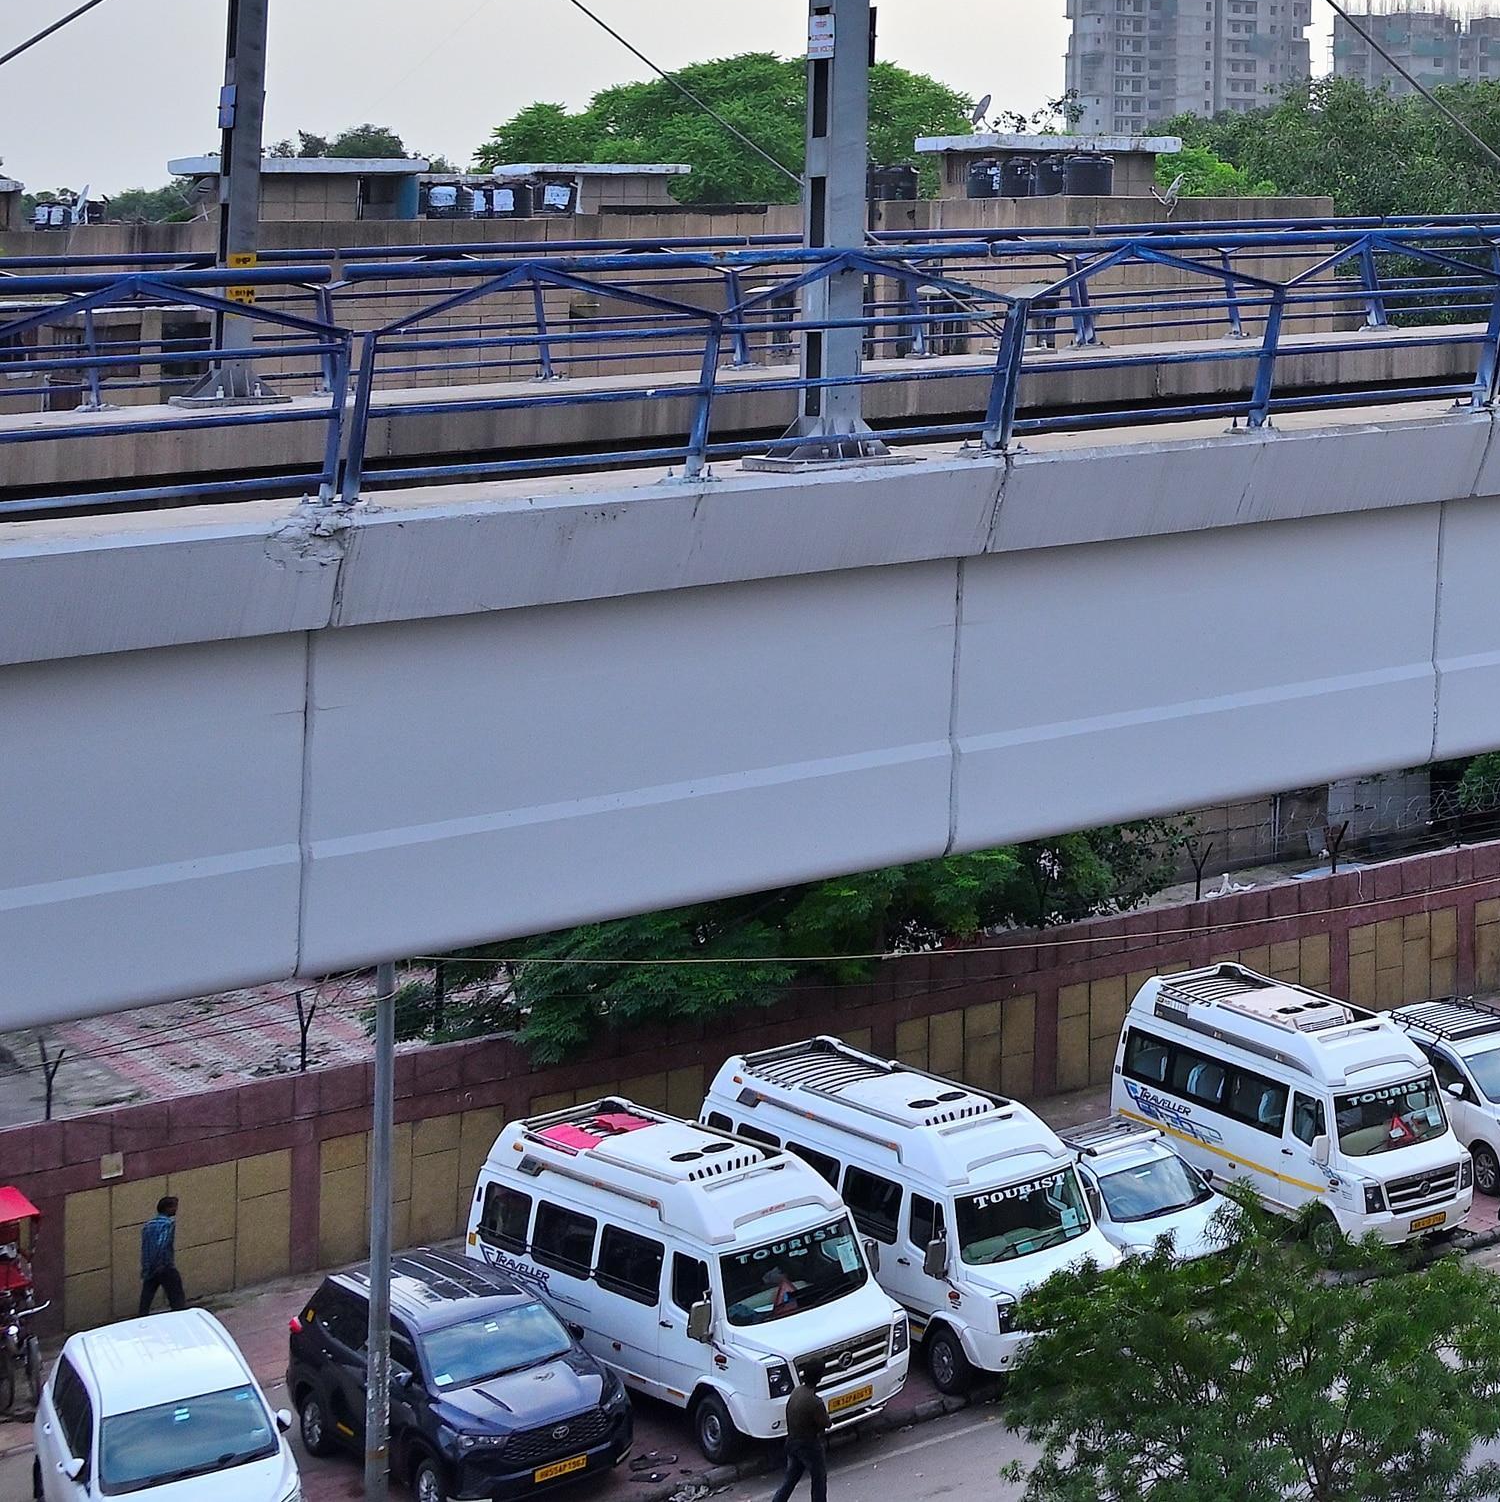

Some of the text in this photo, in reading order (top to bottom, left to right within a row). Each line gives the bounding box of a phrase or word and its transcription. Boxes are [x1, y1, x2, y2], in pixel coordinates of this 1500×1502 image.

[1139, 1085, 1192, 1117] TRAVELLER
[1346, 1079, 1428, 1107] TOURIST
[973, 1172, 1066, 1210] TOURIST
[735, 1223, 840, 1265] TOURIST
[494, 1250, 551, 1283] TRAVELLER
